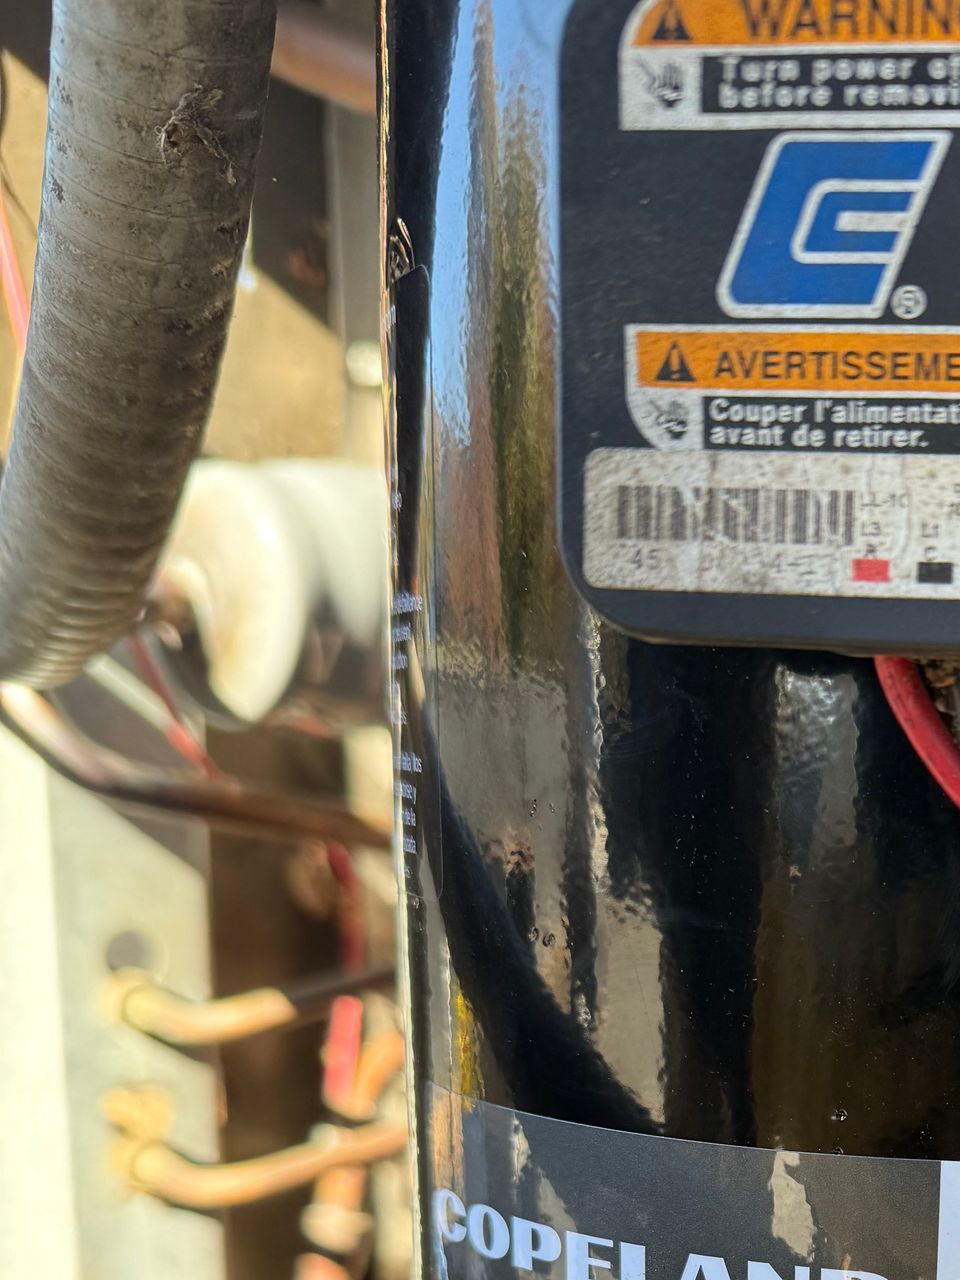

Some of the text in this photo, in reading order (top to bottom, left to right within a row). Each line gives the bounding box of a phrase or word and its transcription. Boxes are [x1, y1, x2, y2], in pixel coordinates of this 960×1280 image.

[719, 56, 802, 82] Turn
[812, 59, 912, 82] power
[719, 82, 832, 106] before
[710, 400, 806, 428] Couper
[710, 425, 929, 448] avant de retirer.
